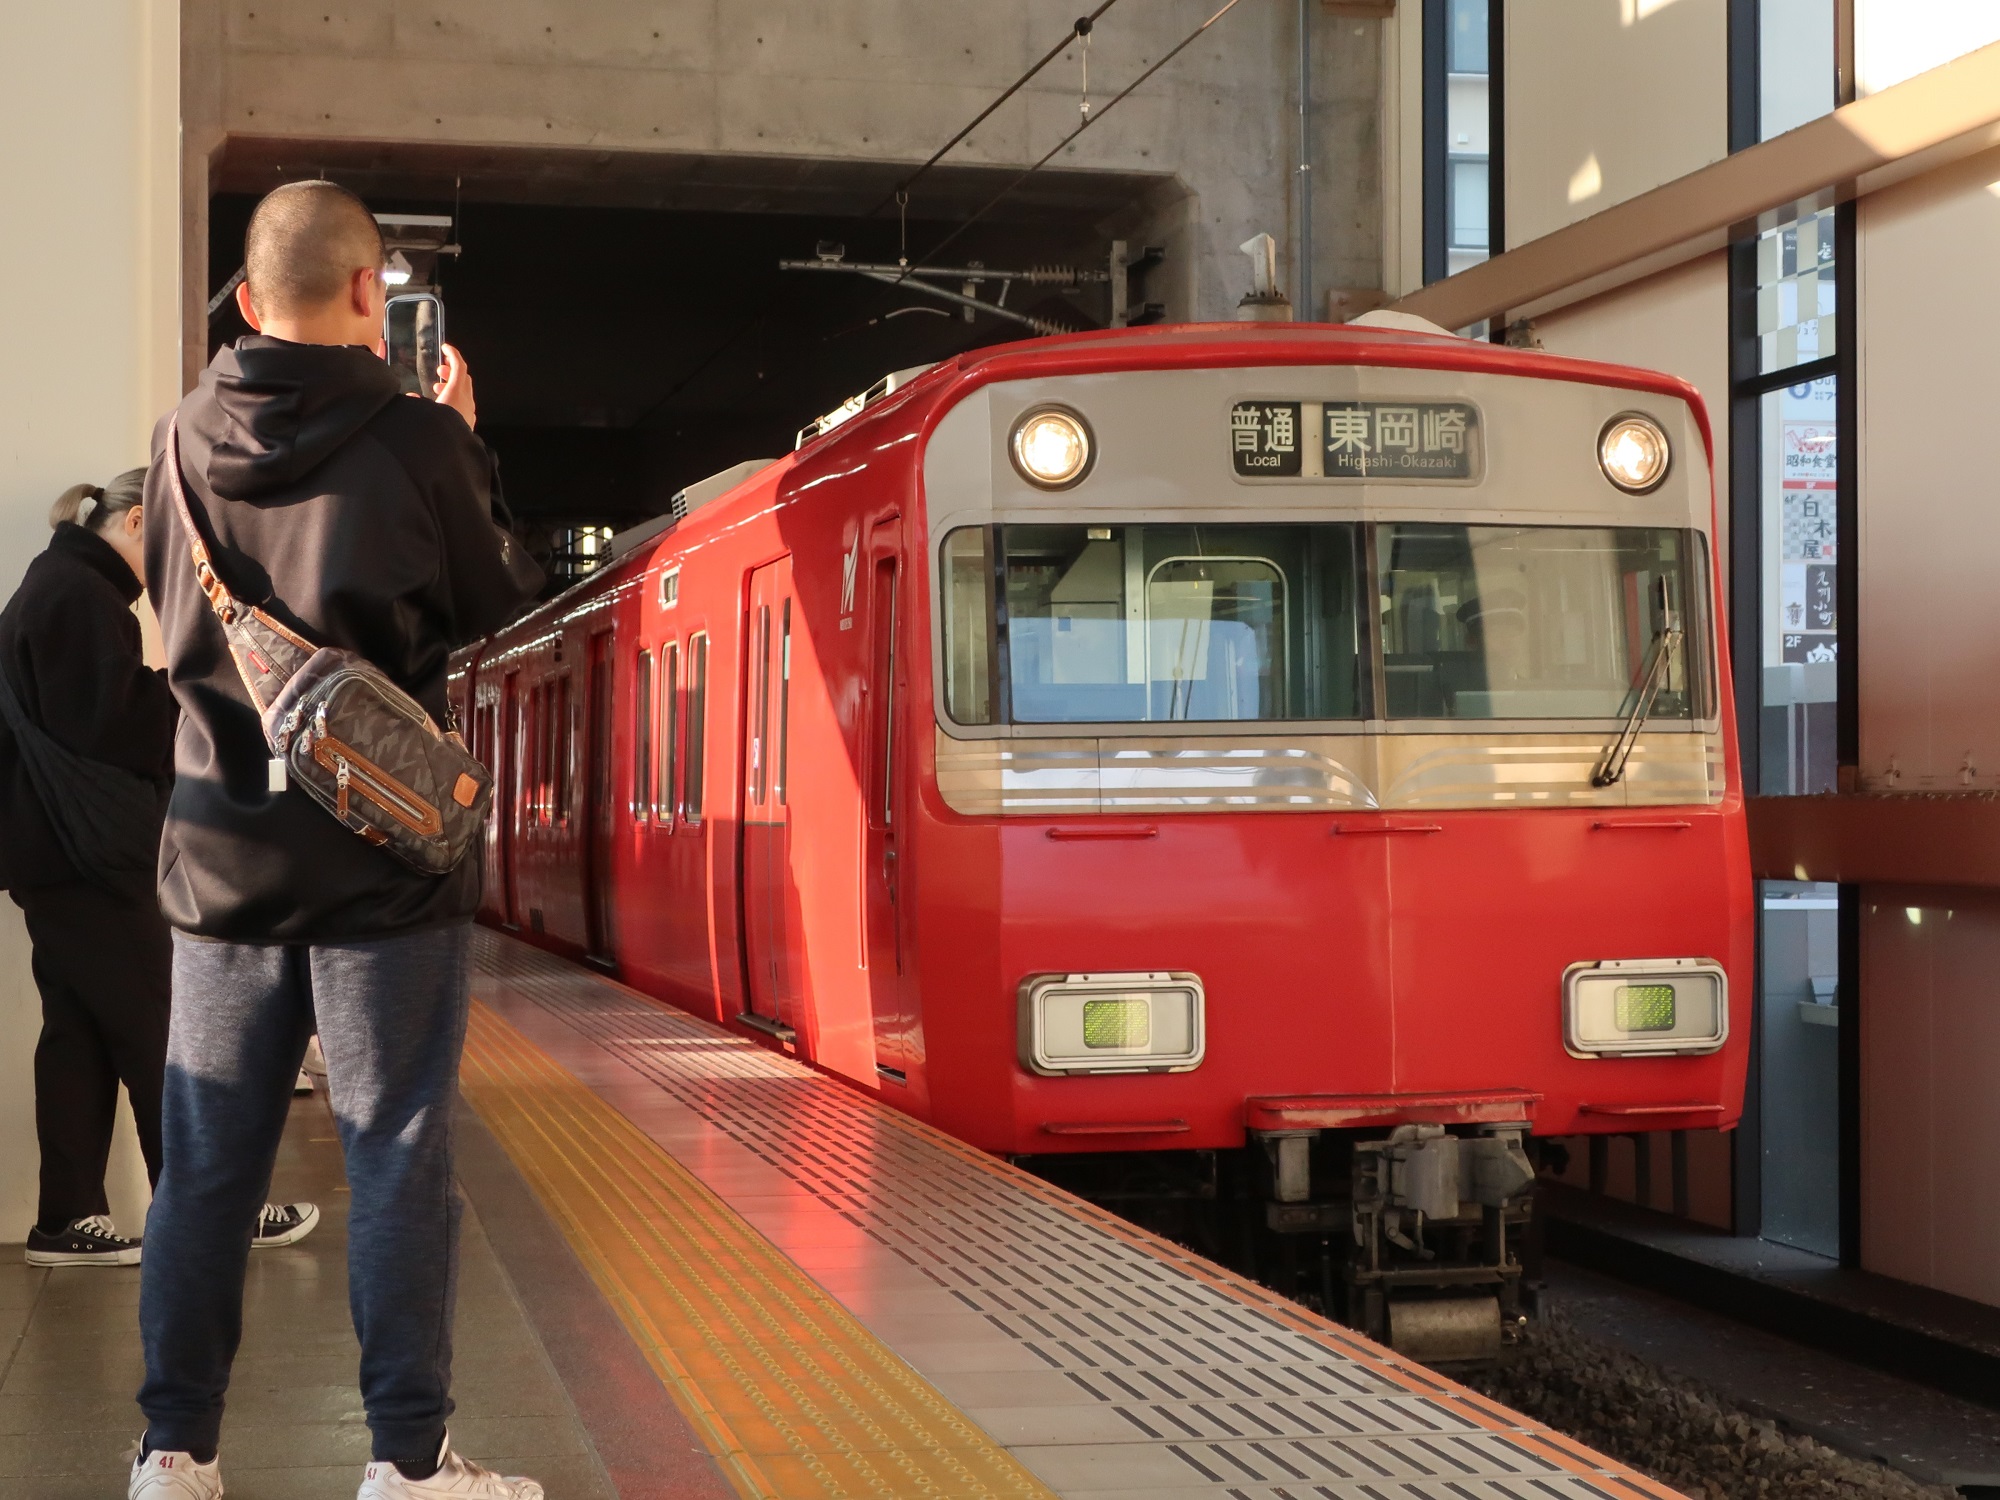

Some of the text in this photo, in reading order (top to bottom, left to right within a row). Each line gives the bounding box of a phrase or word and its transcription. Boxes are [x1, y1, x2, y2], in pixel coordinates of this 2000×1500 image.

[1232, 406, 1467, 454] 普通 東岡崎
[1245, 453, 1457, 471] Local Higashi-Okazaki
[1786, 453, 1836, 469] 昭和食堂
[1803, 494, 1833, 559] 白木屋
[1785, 636, 1802, 648] 2F
[159, 1455, 174, 1469] 41
